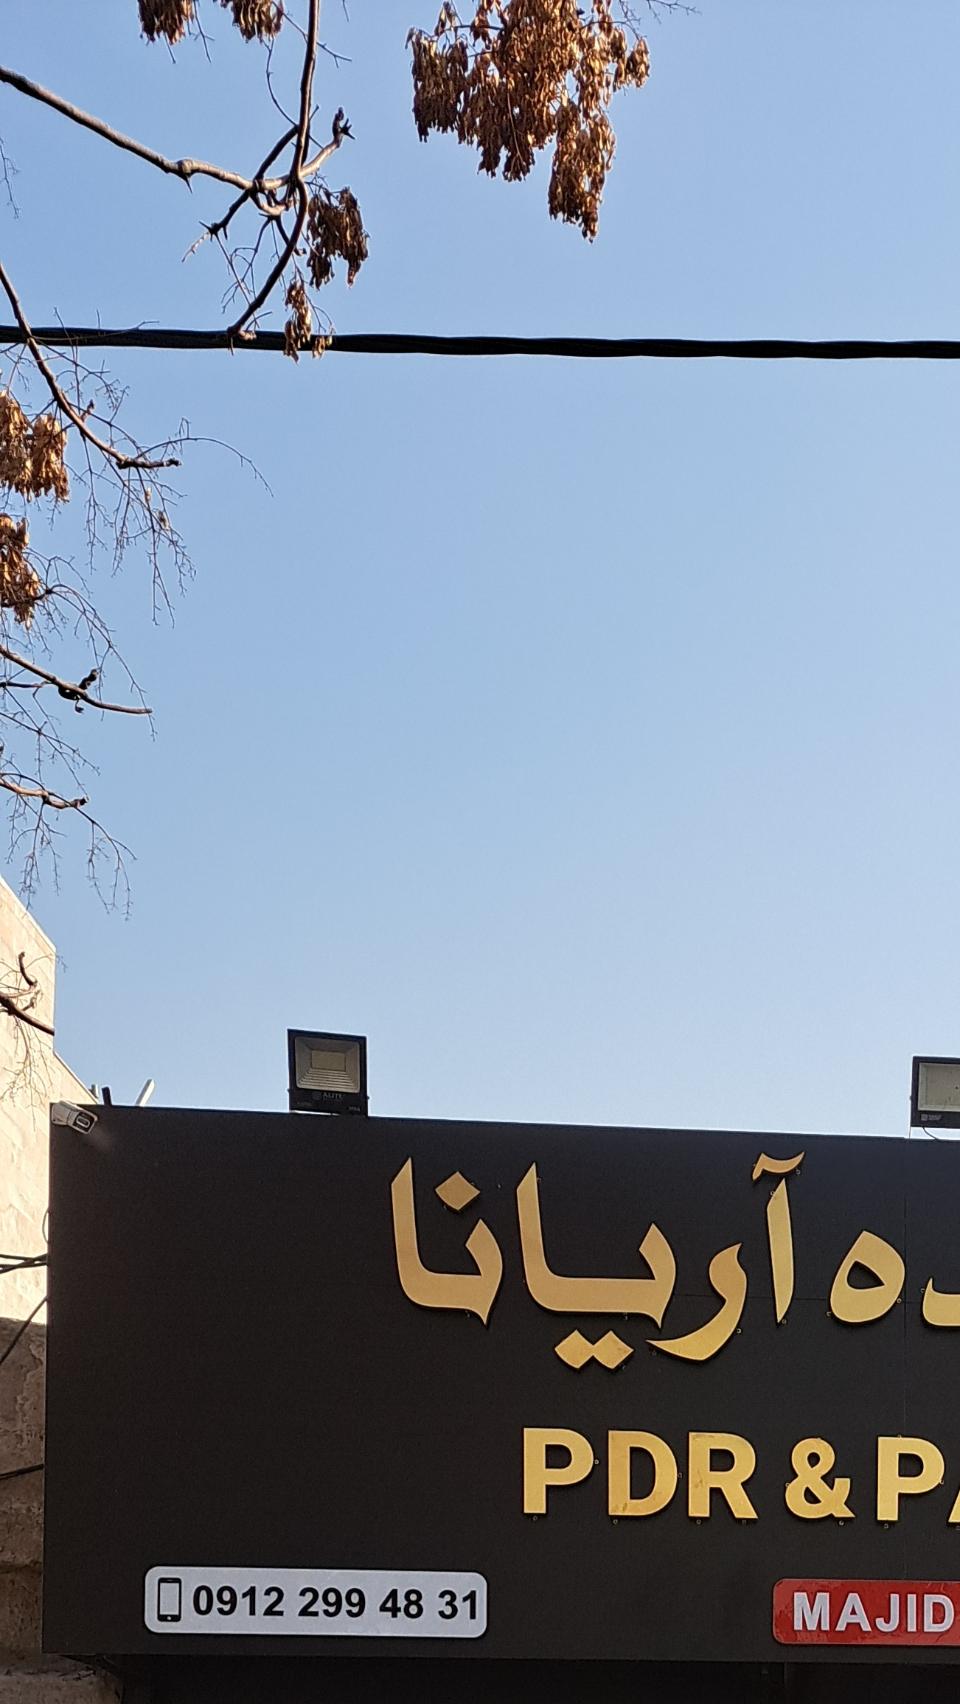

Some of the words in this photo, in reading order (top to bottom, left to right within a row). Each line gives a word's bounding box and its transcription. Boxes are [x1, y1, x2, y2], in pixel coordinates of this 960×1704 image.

[390, 1153, 806, 1371] آریانا
[522, 1426, 759, 1520] PDR
[784, 1437, 856, 1520] &
[192, 1584, 285, 1617] 0912
[297, 1586, 366, 1619] 299
[378, 1588, 424, 1619] 48
[437, 1589, 477, 1620] 31
[792, 1591, 956, 1633] MAJID
